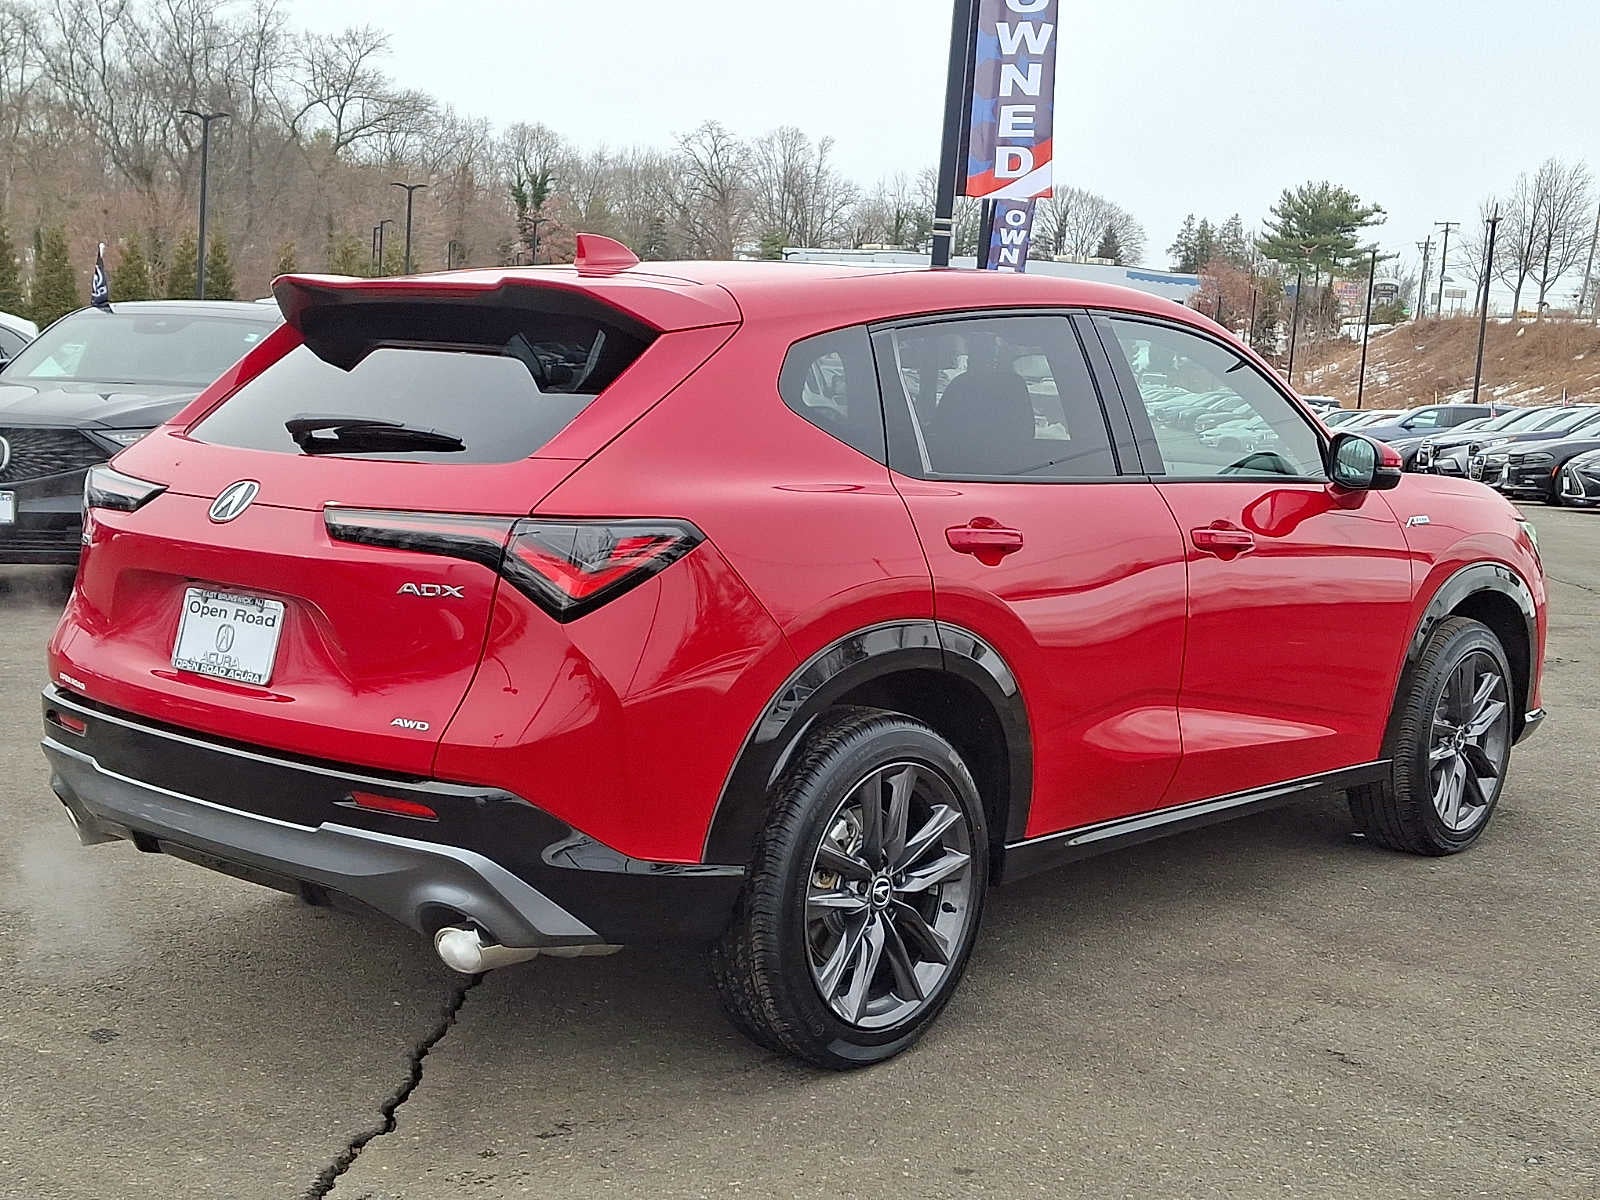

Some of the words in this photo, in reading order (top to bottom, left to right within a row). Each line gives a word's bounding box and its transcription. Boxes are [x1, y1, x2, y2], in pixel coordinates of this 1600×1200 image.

[396, 582, 465, 598] ADX
[189, 600, 228, 619] Open
[233, 608, 277, 627] Road
[175, 659, 199, 672] OPEN
[200, 663, 227, 676] ROAD
[227, 668, 260, 683] ACURA
[390, 718, 430, 731] AWD
